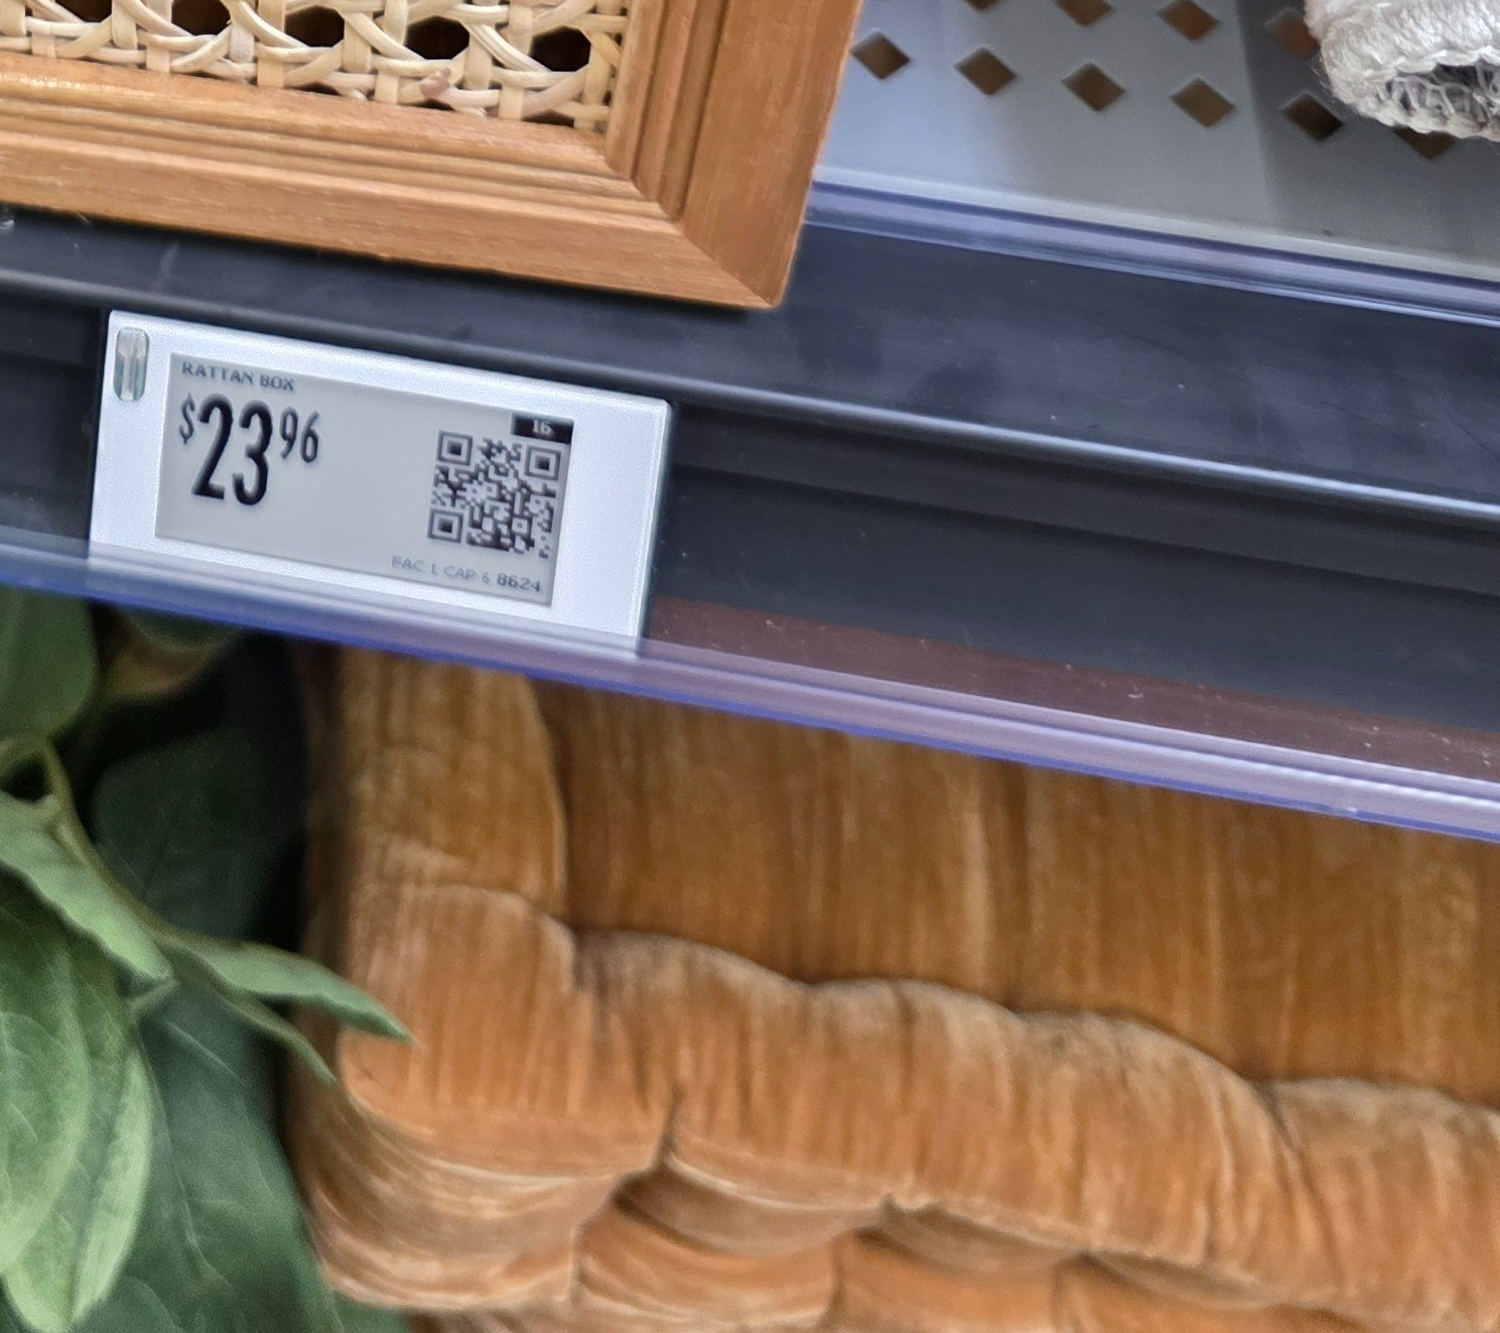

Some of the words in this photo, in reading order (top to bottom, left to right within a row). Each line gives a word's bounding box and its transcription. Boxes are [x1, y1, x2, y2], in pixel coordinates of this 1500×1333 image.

[182, 360, 254, 385] RATTAN
[259, 374, 296, 392] BOX
[391, 555, 424, 573] FAC
[443, 564, 477, 581] CAP
[481, 571, 491, 585] 6
[496, 573, 542, 593] 8624
